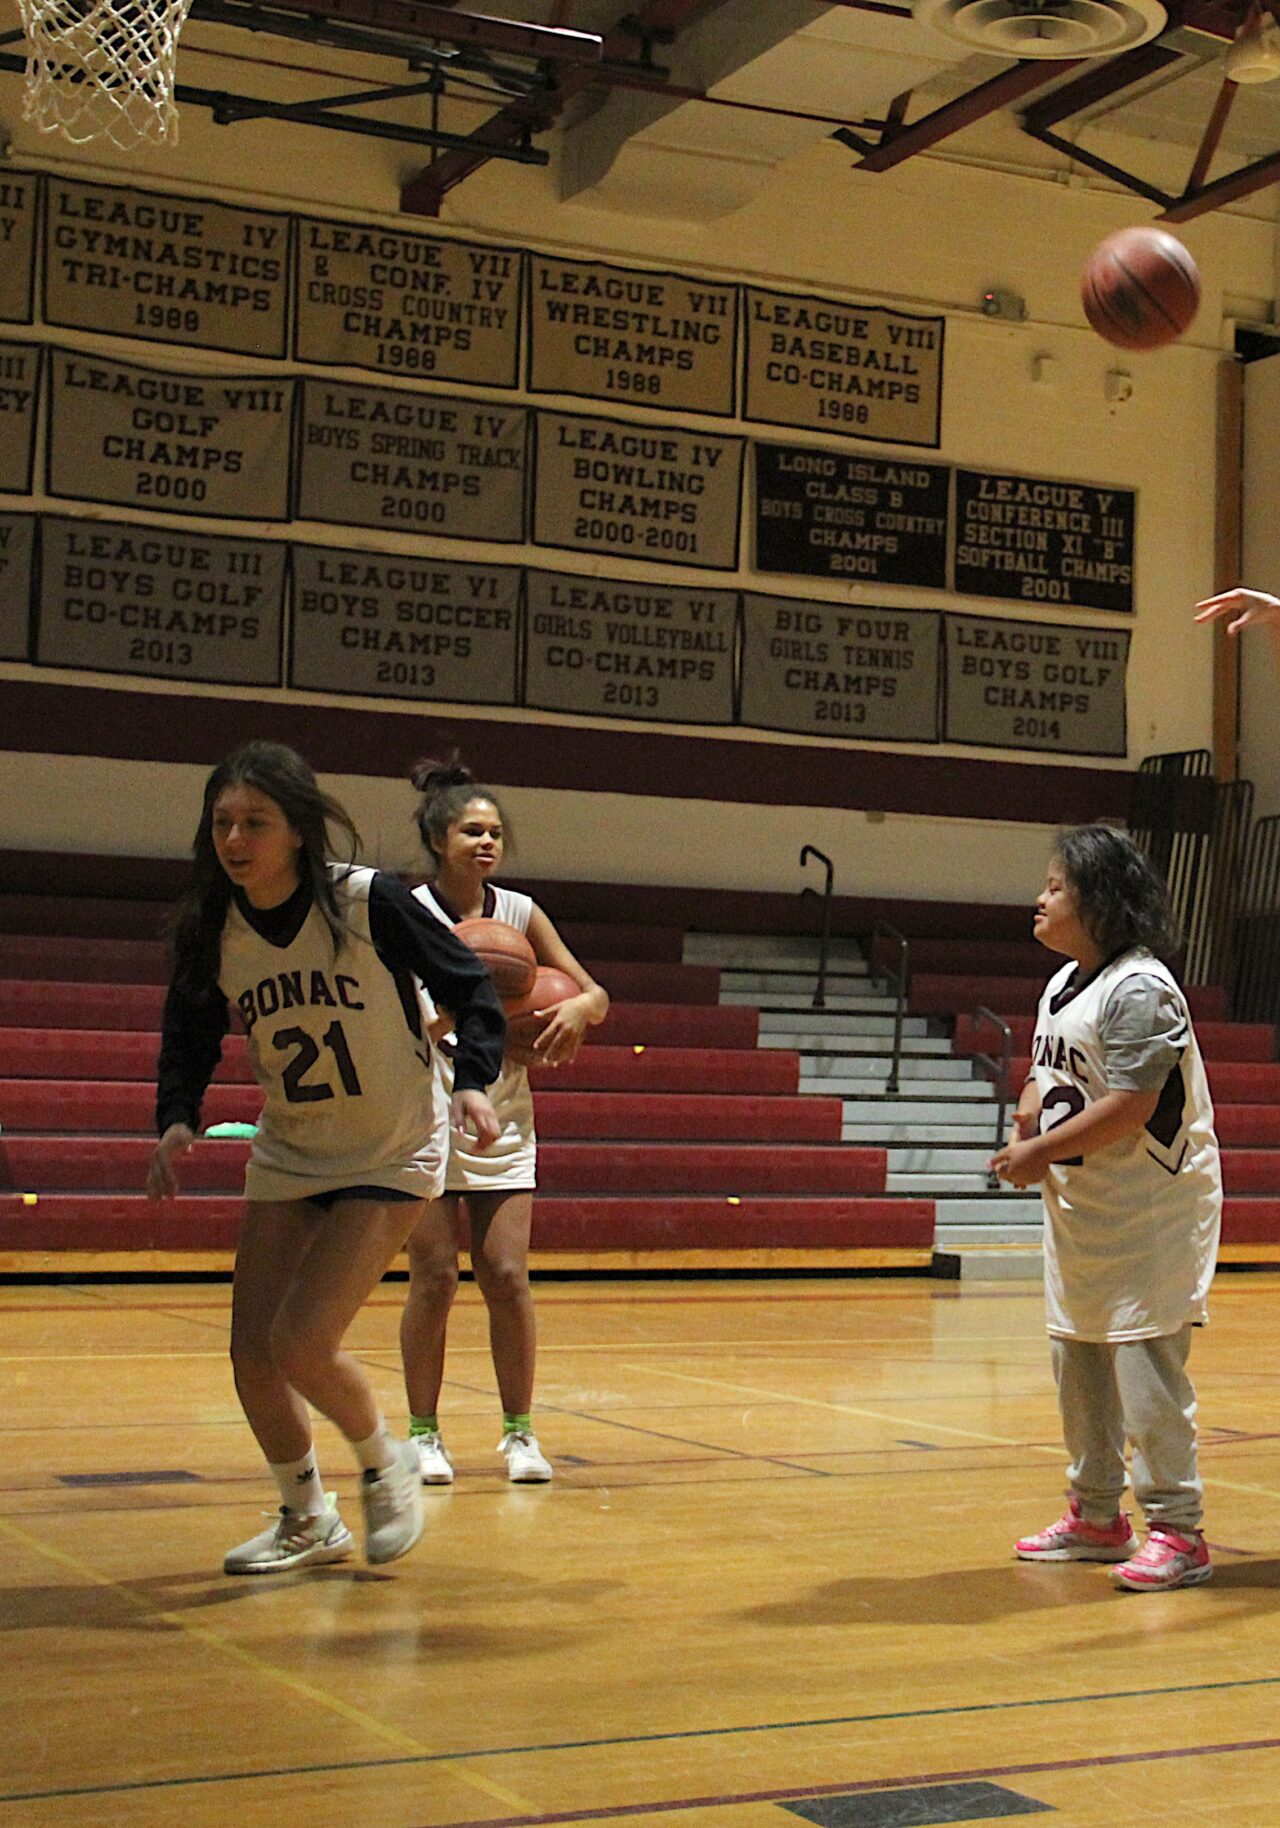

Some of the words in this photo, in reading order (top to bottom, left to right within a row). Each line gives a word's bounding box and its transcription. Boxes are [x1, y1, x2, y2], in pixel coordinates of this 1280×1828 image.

[60, 194, 203, 236] LEAGUE
[243, 224, 278, 250] IV
[55, 225, 280, 282] GYMNASTICS
[310, 227, 443, 267] LEAGUE
[469, 252, 511, 277] VII
[370, 263, 451, 295] CONF.
[472, 279, 503, 301] IV
[541, 269, 664, 306] LEAGUE
[687, 291, 728, 316] VII
[136, 302, 199, 332] 1988
[308, 281, 383, 311] CROSS
[403, 294, 509, 329] COUNTRY
[546, 301, 719, 345] WRESTLING
[344, 312, 471, 351] CHAMPS
[754, 301, 868, 339] LEAGUE
[887, 324, 935, 350] VIII
[377, 344, 436, 370] 1988
[574, 334, 694, 371] CHAMPS
[770, 333, 918, 375] BASEBALL
[65, 364, 203, 406] LEAGUE
[223, 388, 283, 413] VIII
[606, 369, 661, 395] 1988
[132, 407, 220, 438] GOLF
[325, 394, 457, 432] LEAGUE
[474, 415, 507, 438] IV
[818, 398, 869, 424] 1988
[102, 435, 243, 473] CHAMPS
[307, 423, 359, 450] BOYS
[371, 432, 445, 461] SPRING
[457, 443, 521, 470] TRACK
[557, 425, 678, 460] LEAGUE
[691, 445, 723, 467] IV
[136, 472, 206, 501] 2000
[350, 461, 481, 496] CHAMPS
[573, 458, 705, 495] BOWLING
[778, 453, 836, 477] LONG
[847, 462, 931, 489] ISLAND
[381, 496, 445, 522] 2000
[580, 489, 698, 524] CHAMPS
[805, 481, 878, 505] CLASS
[889, 491, 903, 508] B
[979, 480, 1084, 510] LEAGUE
[1097, 494, 1114, 514] V
[574, 518, 697, 553] 2000-2001
[813, 505, 865, 527] CROSS
[875, 511, 945, 535] COUNTRY
[966, 500, 1092, 533] CONFERENCE
[1101, 516, 1125, 538] III
[67, 533, 210, 571] LEAGUE
[229, 552, 261, 575] III
[809, 527, 898, 554] CHAMPS
[964, 522, 1048, 551] SECTION
[1061, 534, 1083, 555] XI
[318, 561, 450, 595] LEAGUE
[466, 575, 499, 598] VI
[958, 545, 1048, 575] SOFTBALL
[1061, 557, 1132, 584] CHAMPS
[64, 564, 154, 597] BOYS
[172, 578, 262, 607] GOLF
[1021, 576, 1072, 600] 2001
[63, 598, 259, 639] CO-CHAMPS
[301, 590, 378, 618] BOYS
[397, 600, 511, 631] SOCCER
[550, 586, 672, 618] LEAGUE
[688, 601, 716, 622] VI
[341, 626, 471, 658] CHAMPS
[534, 613, 592, 640] GIRLS
[606, 621, 728, 653] VOLLEYBALL
[775, 610, 822, 634] BIG
[837, 617, 909, 642] FOUR
[957, 627, 1061, 656] LEAGUE
[1075, 639, 1119, 661] VIII
[129, 637, 193, 665] 2013
[770, 638, 829, 663] GIRLS
[843, 645, 914, 670] TENNIS
[376, 661, 435, 686] 2013
[785, 668, 897, 697] CHAMPS
[962, 655, 1030, 681] BOYS
[1043, 663, 1112, 687] GOLF
[604, 682, 659, 707] 2013
[815, 700, 866, 724] 2013
[983, 685, 1091, 714] CHAMPS
[1013, 716, 1060, 739] 2014
[237, 969, 364, 1028] BONAC
[272, 1019, 363, 1103] 21
